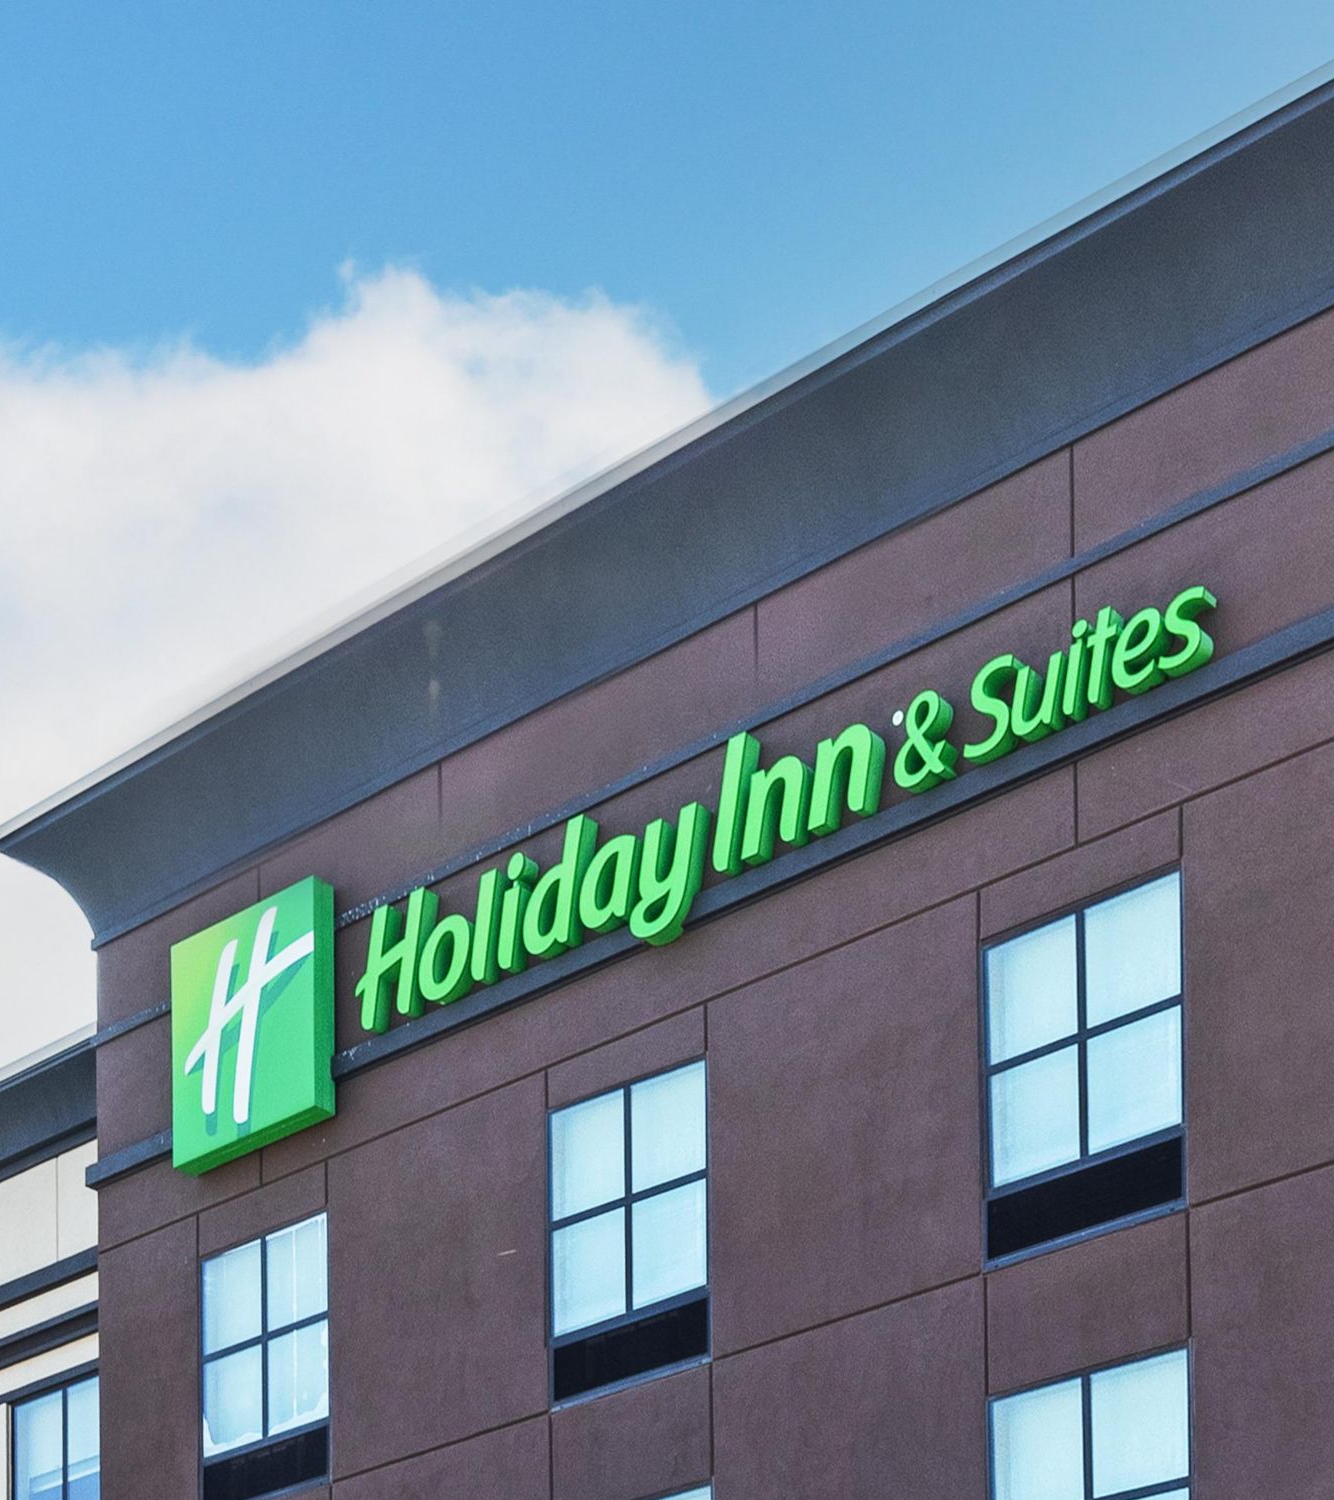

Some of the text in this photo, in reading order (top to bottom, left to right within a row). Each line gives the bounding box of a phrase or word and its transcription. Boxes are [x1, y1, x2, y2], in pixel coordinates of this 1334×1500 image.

[355, 586, 1216, 1033] Holiday Inn & Suites
[184, 906, 314, 1124] H
